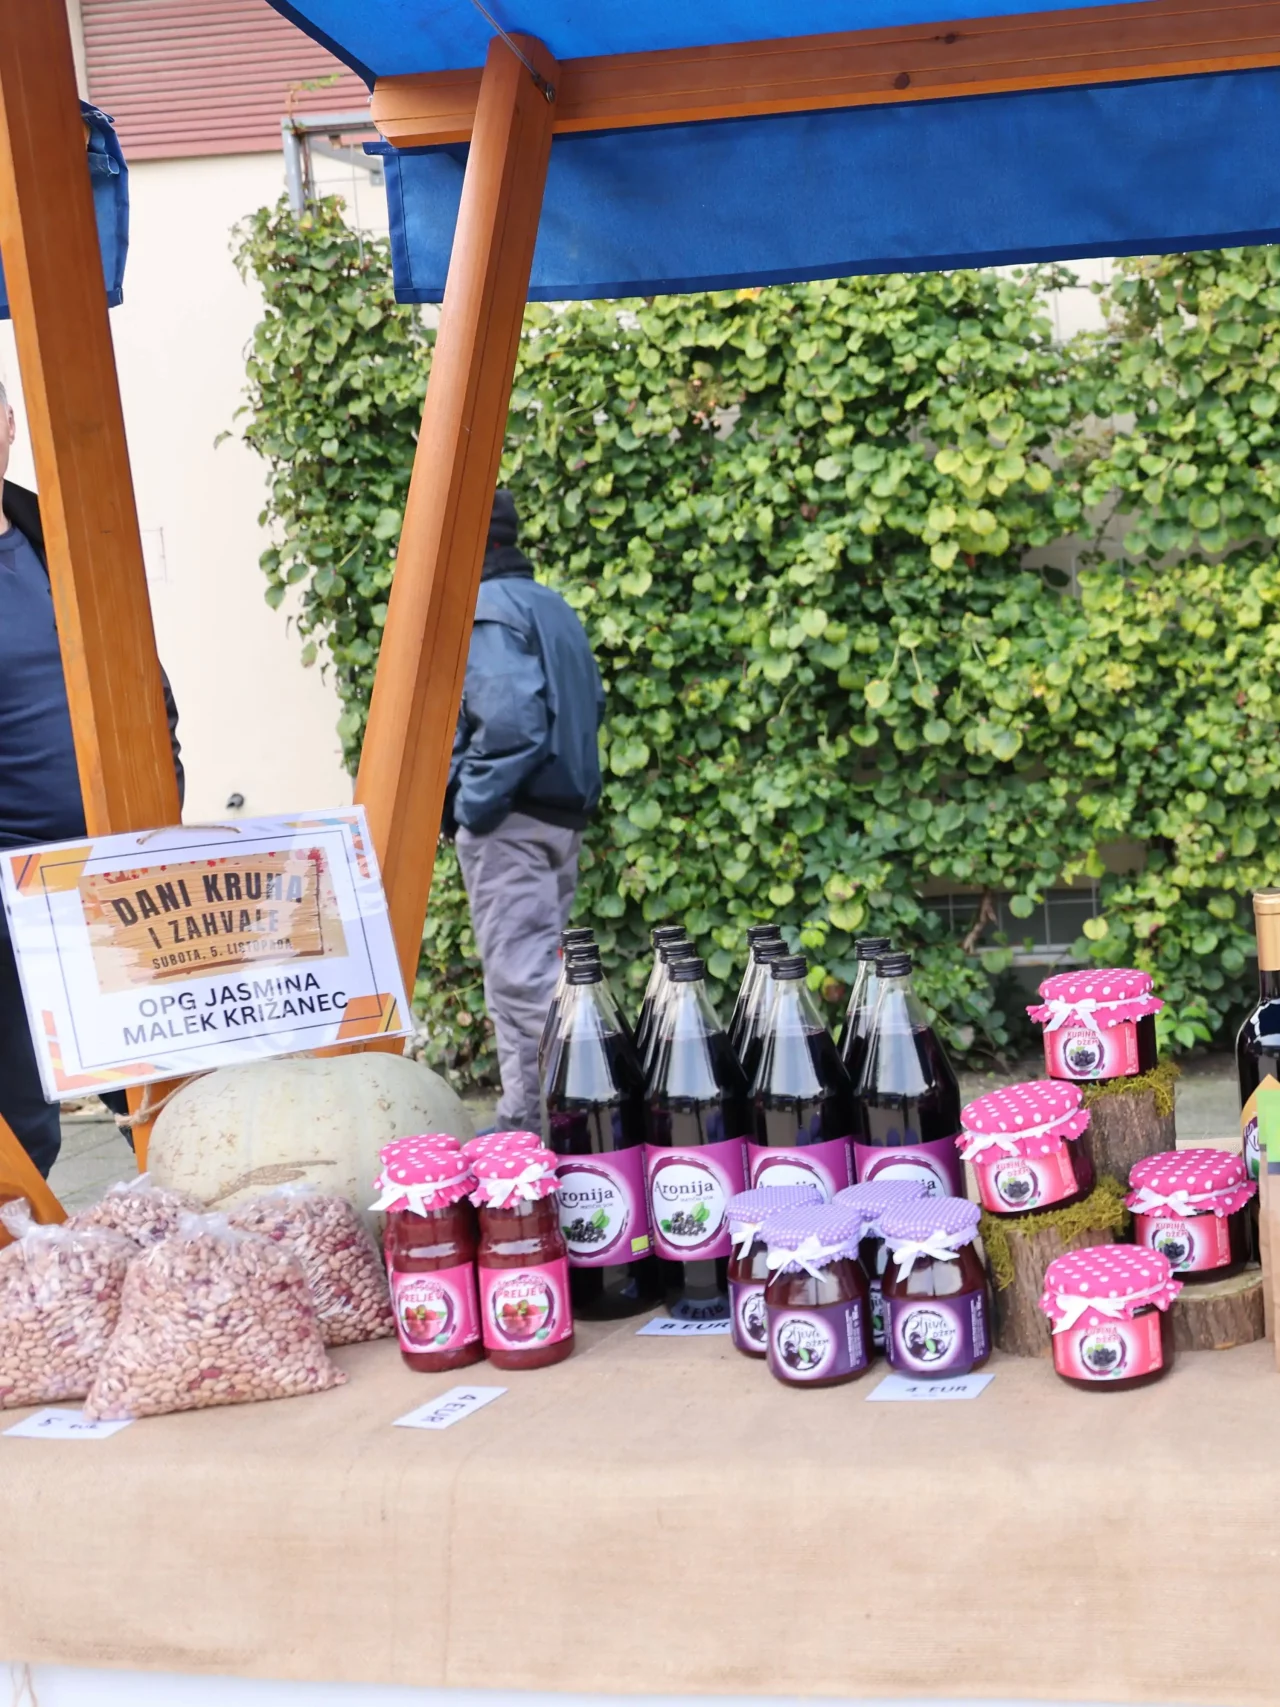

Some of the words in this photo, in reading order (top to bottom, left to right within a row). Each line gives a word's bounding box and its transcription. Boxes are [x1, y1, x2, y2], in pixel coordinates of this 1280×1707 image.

[111, 879, 191, 927] DANI
[203, 872, 302, 903] KRUHA
[148, 927, 162, 949] I
[168, 909, 279, 944] ZAHVALE
[210, 946, 223, 957] 5.
[227, 938, 292, 955] LISTOPADA
[139, 992, 197, 1018] OPG
[205, 973, 321, 1007] JASMINA
[123, 1012, 218, 1046] MALEK
[224, 991, 348, 1028] KRIŽANEC
[1067, 1030, 1097, 1039] KUPINA
[559, 1187, 614, 1208] ronija
[655, 1180, 715, 1202] Aronija
[1155, 1222, 1186, 1230] KUPINA
[681, 1322, 730, 1330] EUR
[929, 1385, 968, 1393] EUR
[38, 1417, 64, 1427] 5
[420, 1402, 466, 1422] EUR
